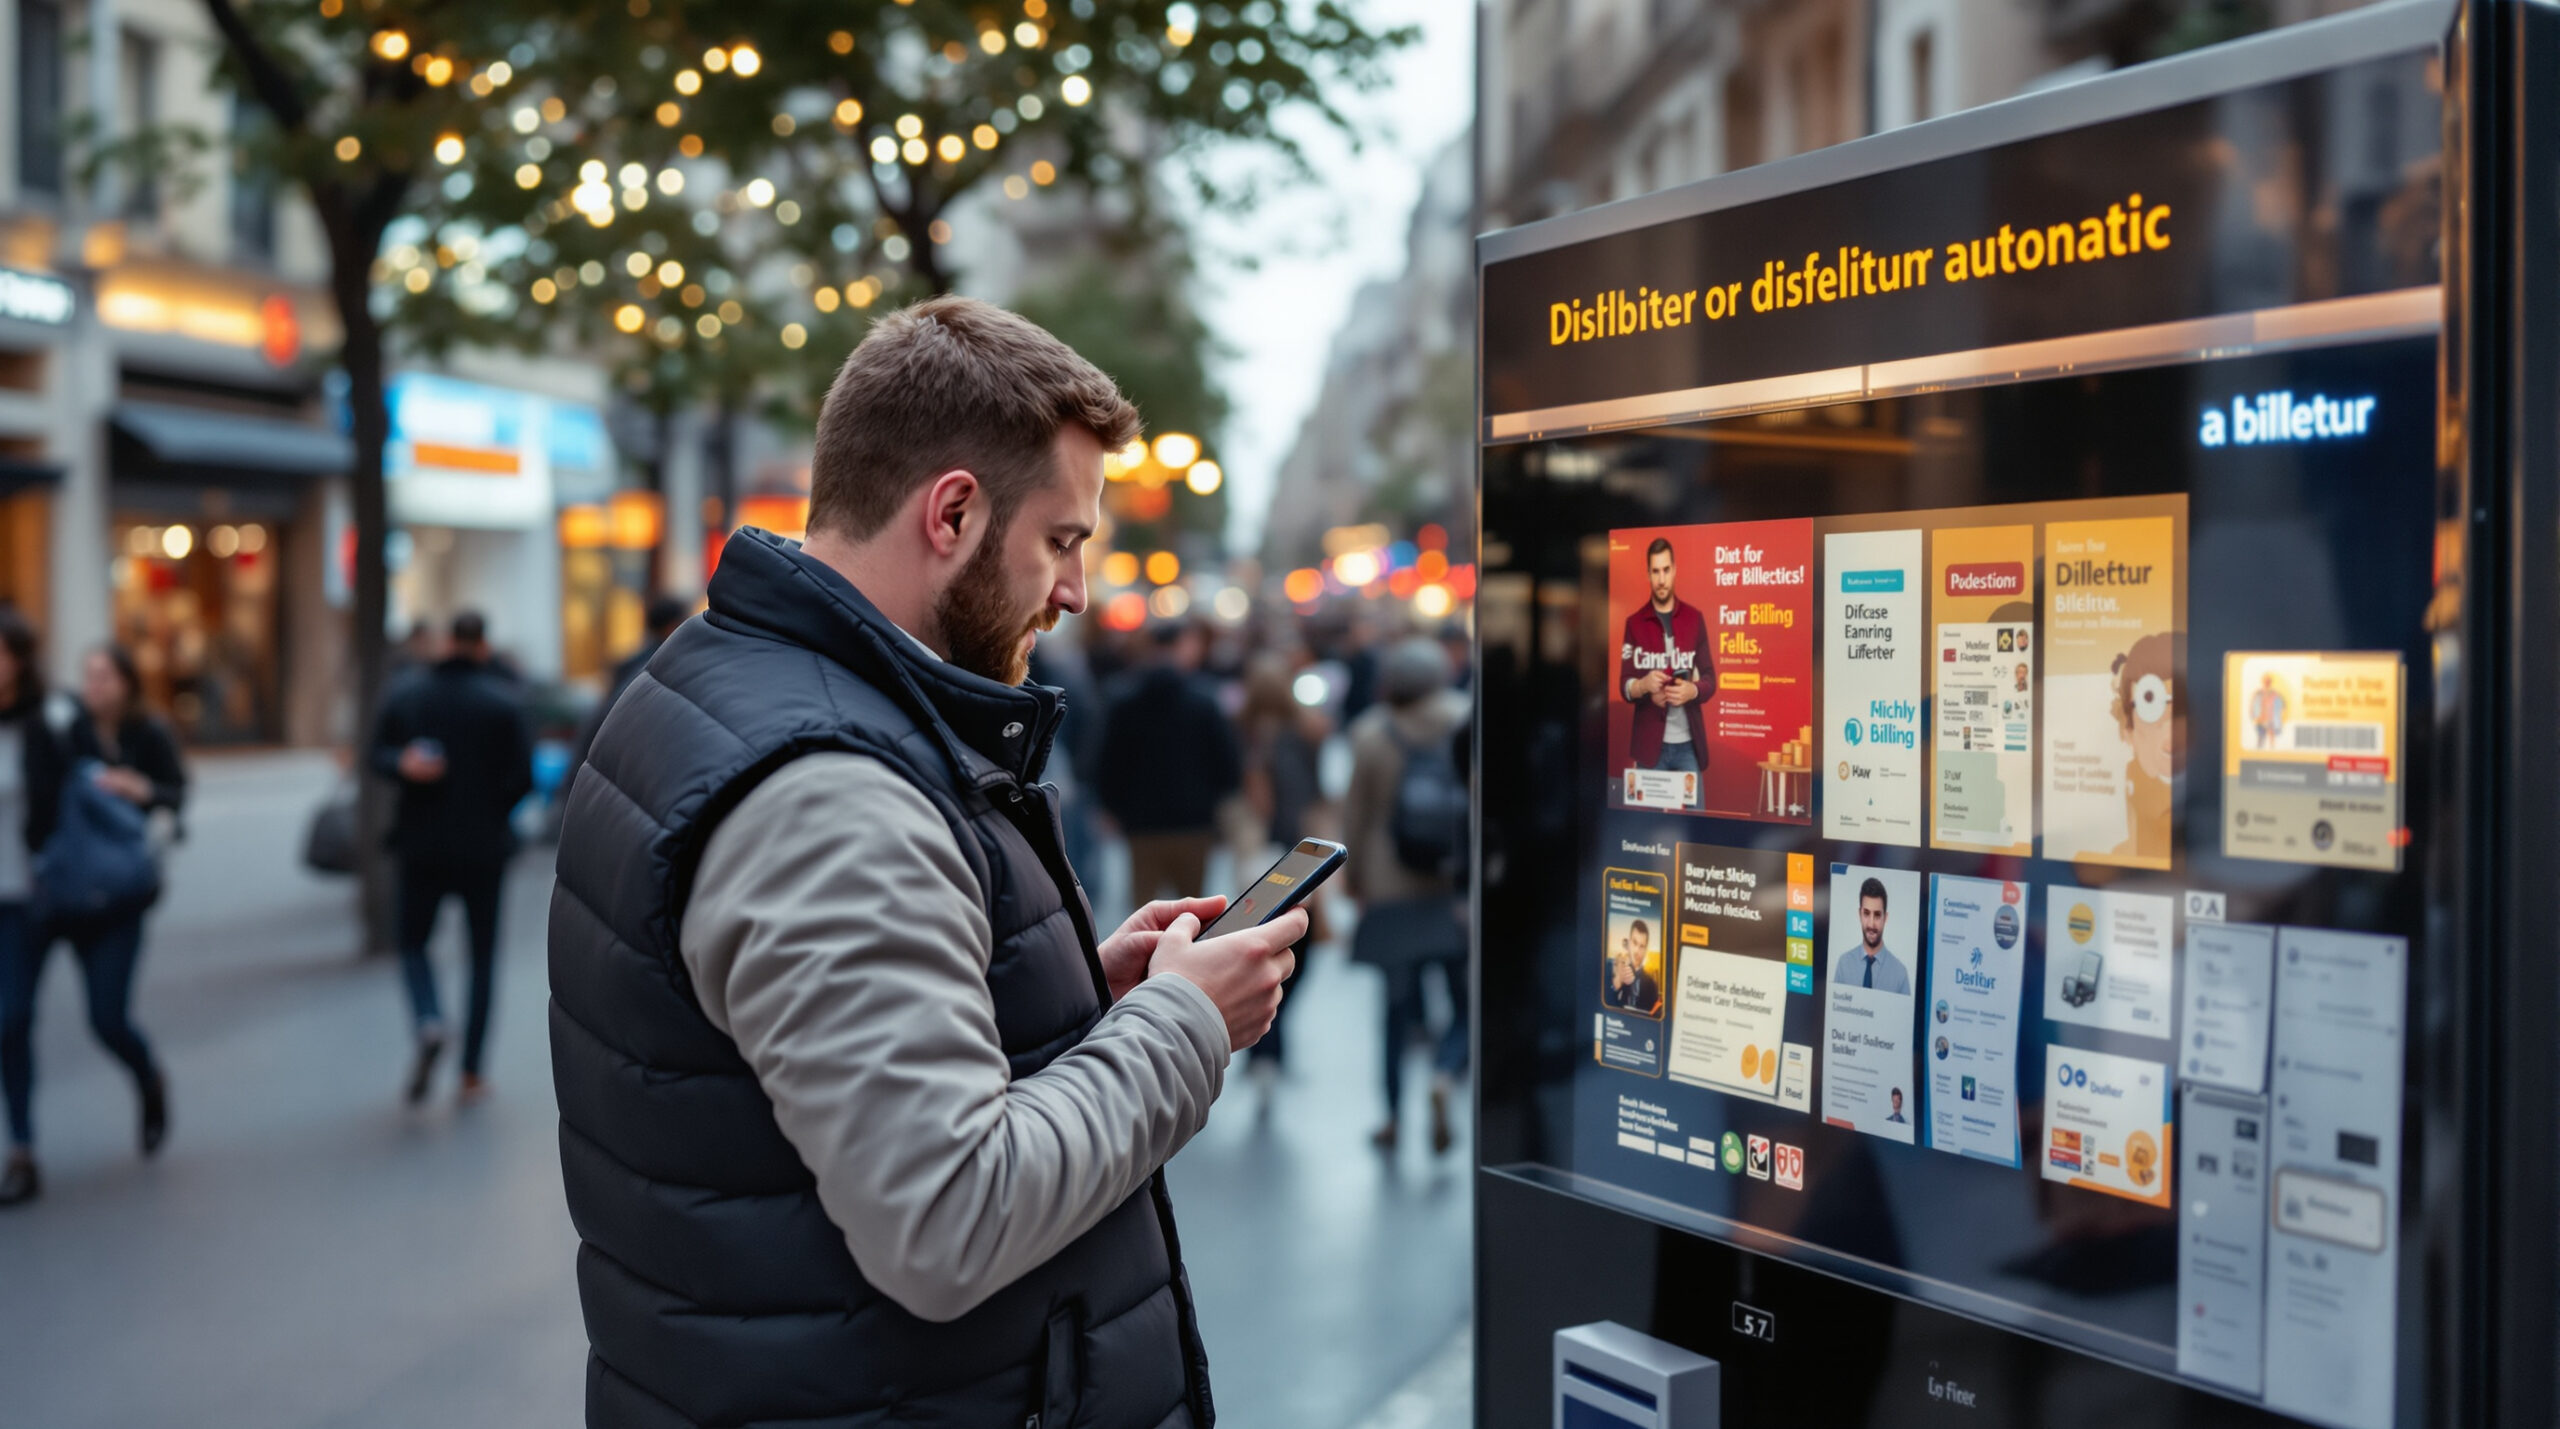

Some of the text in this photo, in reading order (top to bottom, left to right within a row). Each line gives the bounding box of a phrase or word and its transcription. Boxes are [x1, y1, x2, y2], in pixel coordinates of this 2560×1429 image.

[1705, 282, 1742, 321] or
[1944, 192, 2172, 282] autonatic
[2200, 390, 2376, 447] a billetur
[1743, 544, 1763, 564] for
[1870, 723, 1915, 749] Billing
